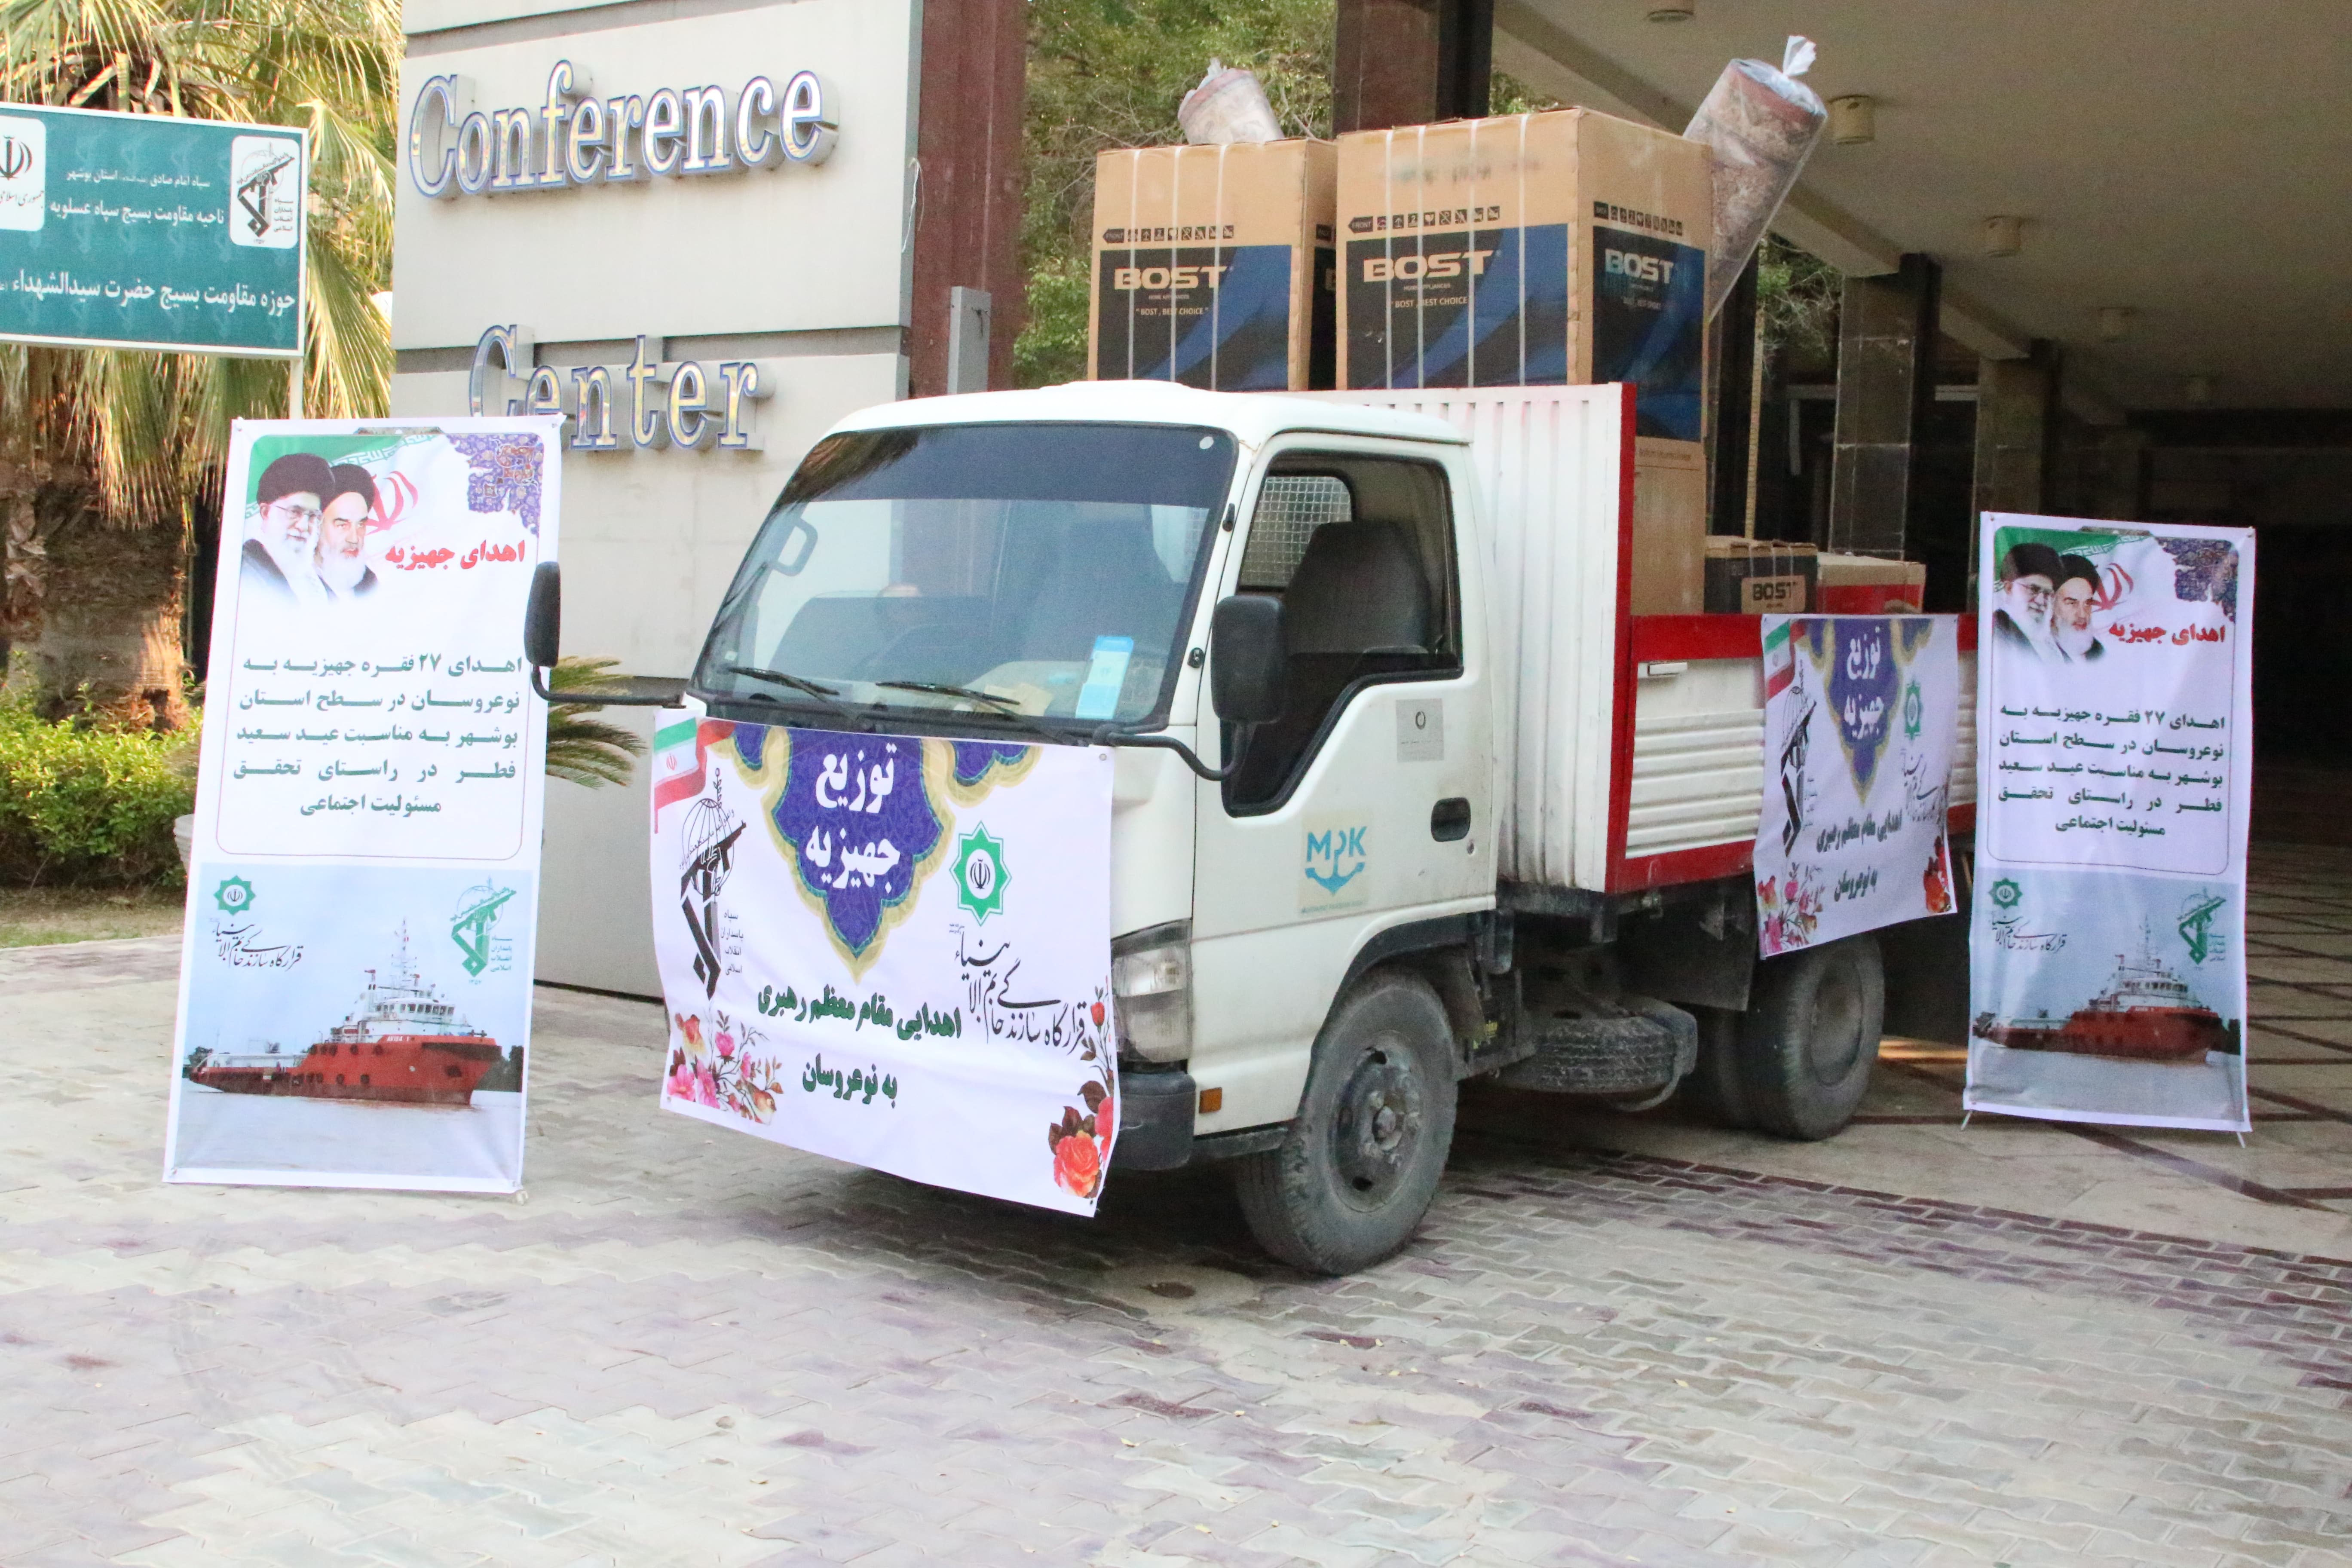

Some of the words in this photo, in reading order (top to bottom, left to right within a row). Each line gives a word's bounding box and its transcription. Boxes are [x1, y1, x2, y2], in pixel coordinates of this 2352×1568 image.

[408, 60, 824, 198] Conference
[49, 197, 91, 219] عسلویه
[94, 200, 119, 222] سپاه
[122, 206, 151, 224] بسیج
[155, 205, 193, 226] مقاومت
[196, 208, 224, 227] ناحیه
[1363, 250, 1494, 282] BOST
[1605, 248, 1674, 284] BOST
[13, 269, 100, 302] سیدالشهداء
[1115, 266, 1228, 290] BOST
[105, 278, 155, 307] حضرت
[160, 286, 199, 309] بسیج
[204, 283, 256, 312] مقاومت
[260, 290, 295, 317] حوزه
[1439, 297, 1468, 305] CHOICE
[468, 324, 760, 448] Center
[385, 545, 455, 570] جهیزیه
[460, 539, 524, 569] اهدای
[2109, 622, 2166, 644] جهیزیه
[2172, 623, 2225, 645] اهدای
[420, 653, 441, 671] ۲۷
[1847, 626, 1880, 680] توزیع
[244, 658, 277, 675] به
[283, 658, 356, 677] جهیزیه
[361, 655, 414, 677] فقره
[448, 655, 521, 677] اهدای
[240, 689, 310, 710] استان
[317, 690, 383, 711] سطح
[388, 693, 405, 711] در
[412, 689, 519, 713] نوعروسان
[1844, 693, 1884, 740] جهیزیه
[2000, 705, 2027, 720] به
[2032, 706, 2091, 723] جهیزیه
[2095, 709, 2140, 726] فقره
[2170, 713, 2225, 730] اهدای
[237, 727, 291, 744] سعید
[296, 729, 338, 745] عید
[345, 724, 412, 745] مناسبت
[419, 729, 450, 746] به
[455, 727, 518, 749] بوشهر
[2000, 730, 2057, 746] استان
[2063, 732, 2114, 749] سطح
[2120, 740, 2136, 754] در
[2142, 738, 2223, 761] نوعروسان
[234, 759, 301, 779] تحقق
[318, 759, 398, 781] راستای
[417, 764, 437, 782] در
[455, 761, 515, 783] فطر
[816, 743, 897, 813] توزیع
[1999, 760, 2042, 774] سعید
[2047, 762, 2082, 776] عید
[2088, 765, 2144, 778] مناسبت
[2149, 769, 2171, 784] به
[2174, 771, 2223, 788] بوشهر
[301, 794, 365, 815] اجتماعی
[371, 794, 441, 817] مسئولیت
[1999, 787, 2053, 802] تحقق
[2068, 787, 2133, 809] راستای
[2146, 797, 2162, 811] در
[2175, 797, 2222, 814] فطر
[2055, 815, 2113, 833] اجتماعی
[805, 826, 900, 894] جهیزیه
[758, 985, 807, 1022] رهبری
[809, 984, 856, 1024] معظم
[856, 992, 894, 1032] مقام
[897, 1002, 962, 1041] اهدایی
[802, 1053, 878, 1105] نوعروسان
[882, 1074, 897, 1109] به
